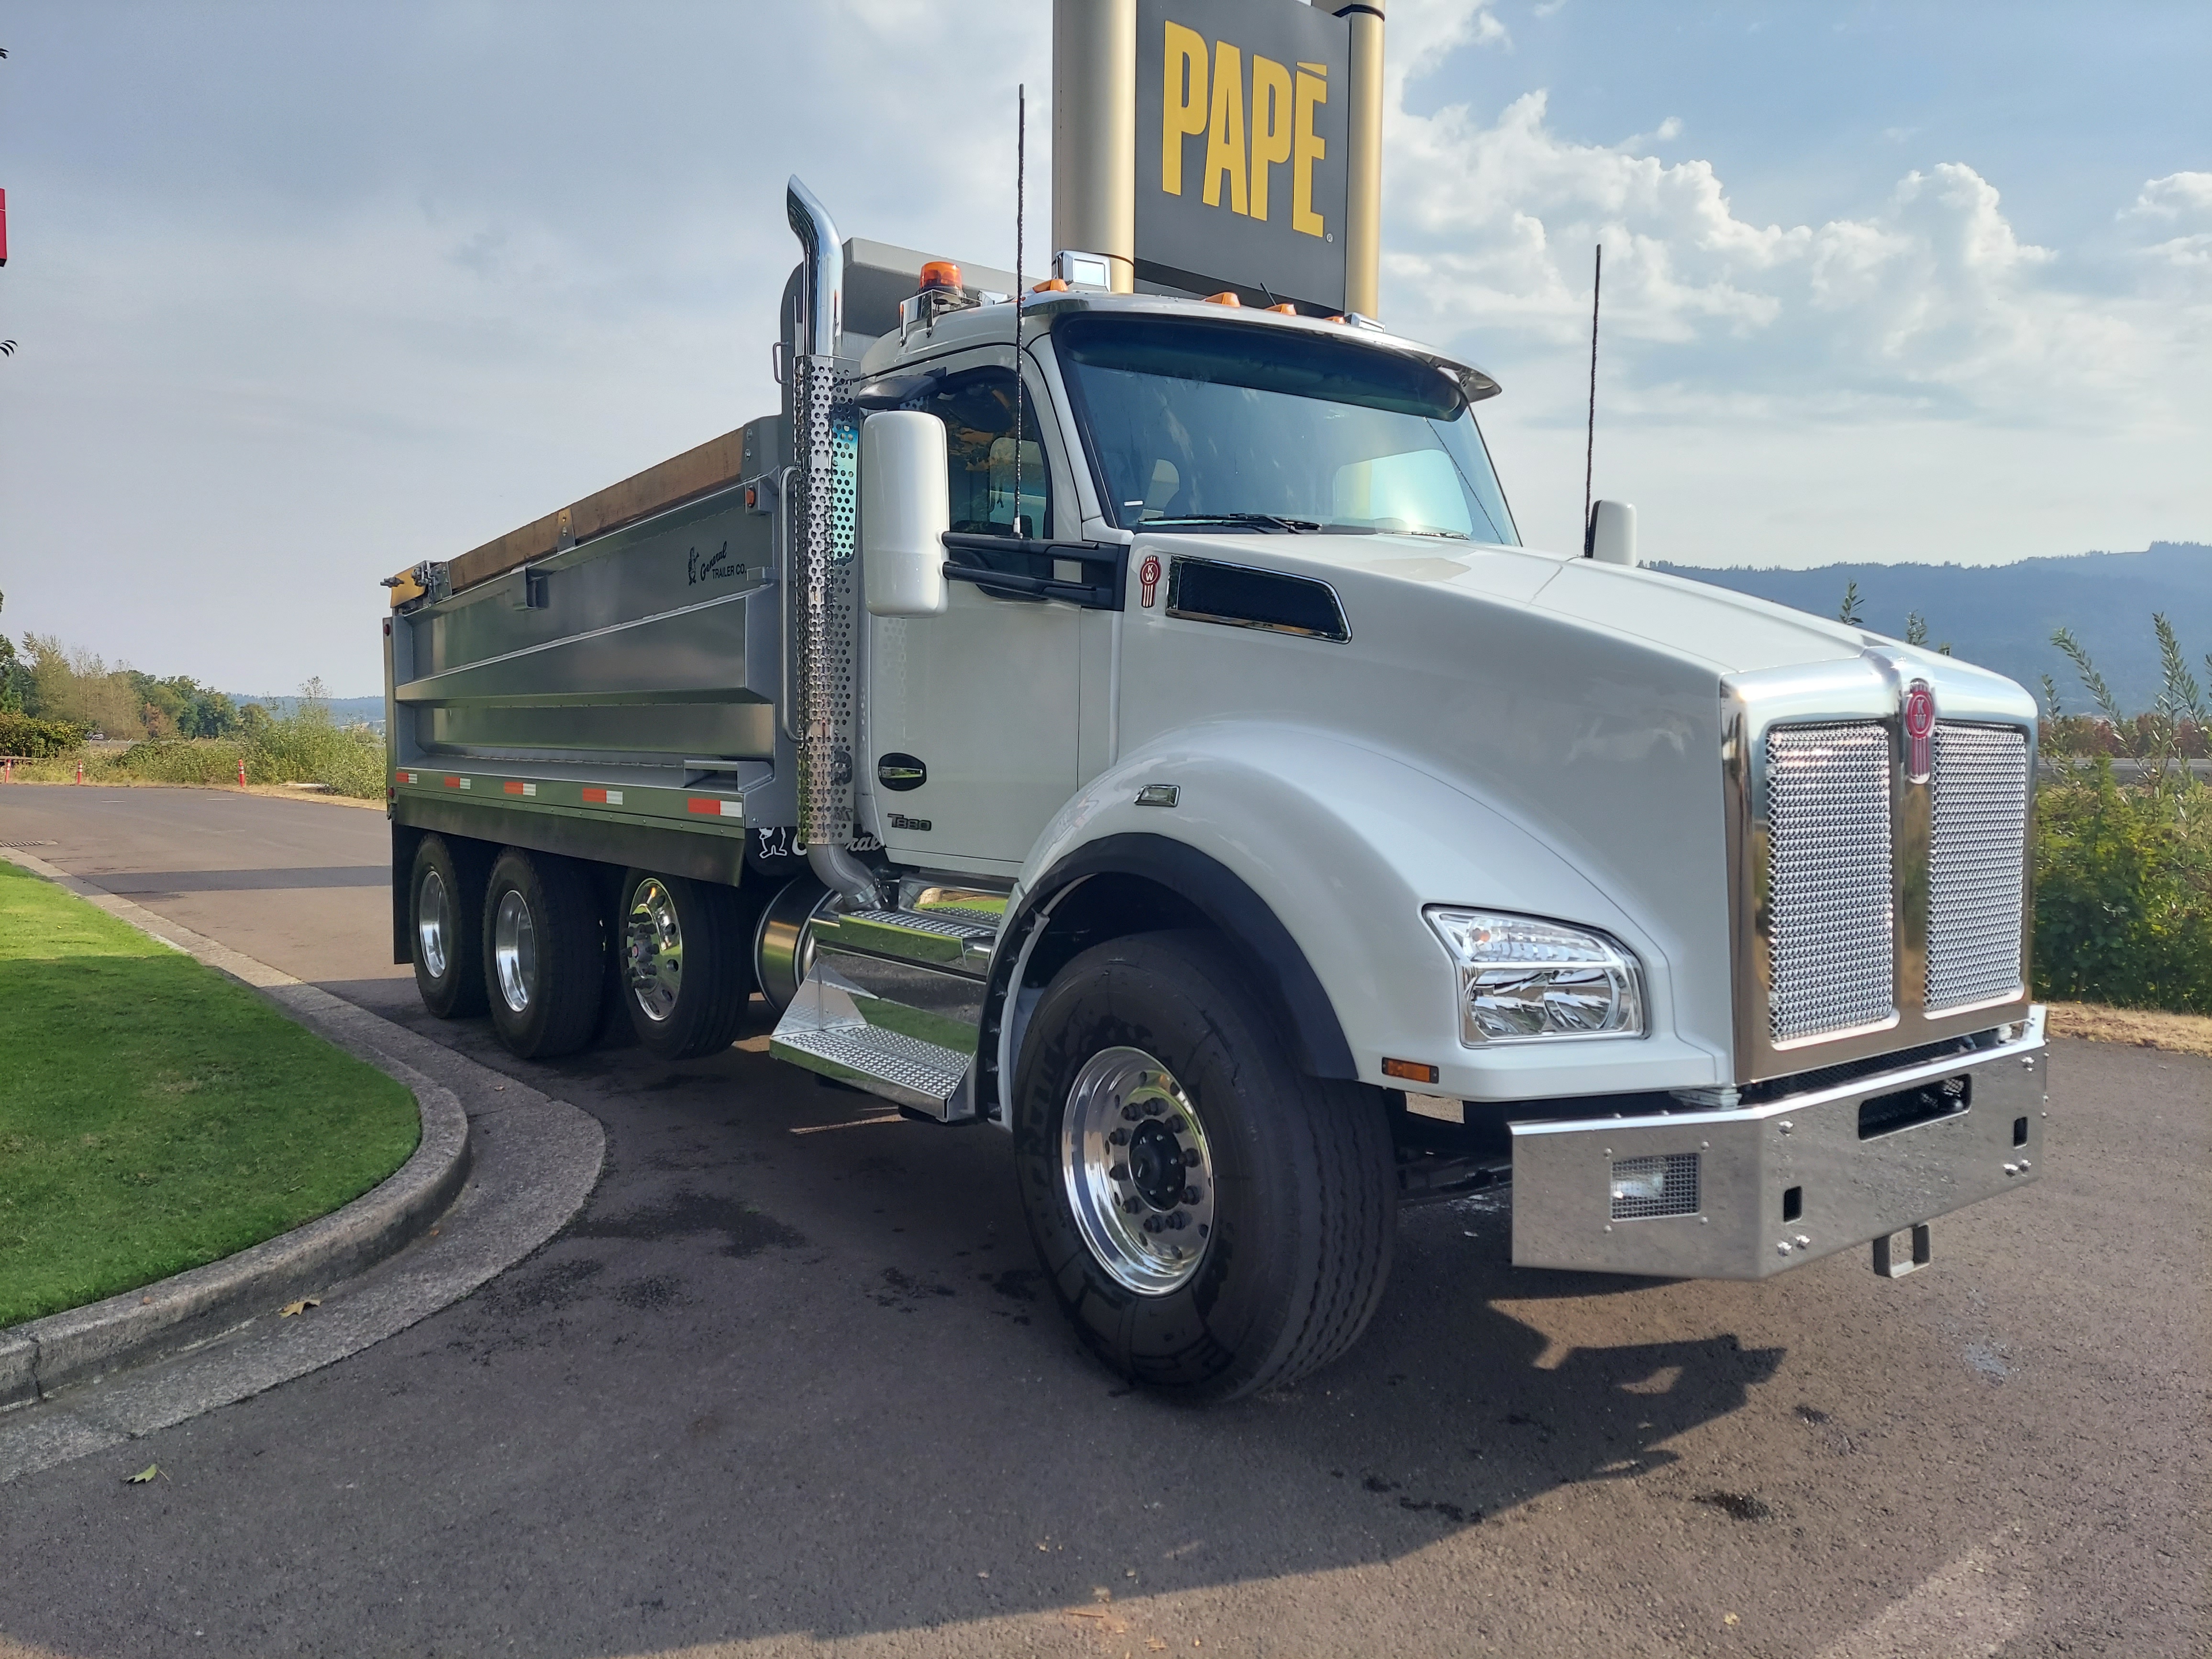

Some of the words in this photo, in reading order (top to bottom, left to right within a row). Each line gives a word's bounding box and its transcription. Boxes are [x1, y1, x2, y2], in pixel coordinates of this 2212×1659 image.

[1161, 20, 1328, 238] PAPÉ
[700, 541, 727, 581] General
[712, 565, 734, 579] TRAILER
[736, 563, 746, 575] CO.
[887, 813, 931, 831] T880
